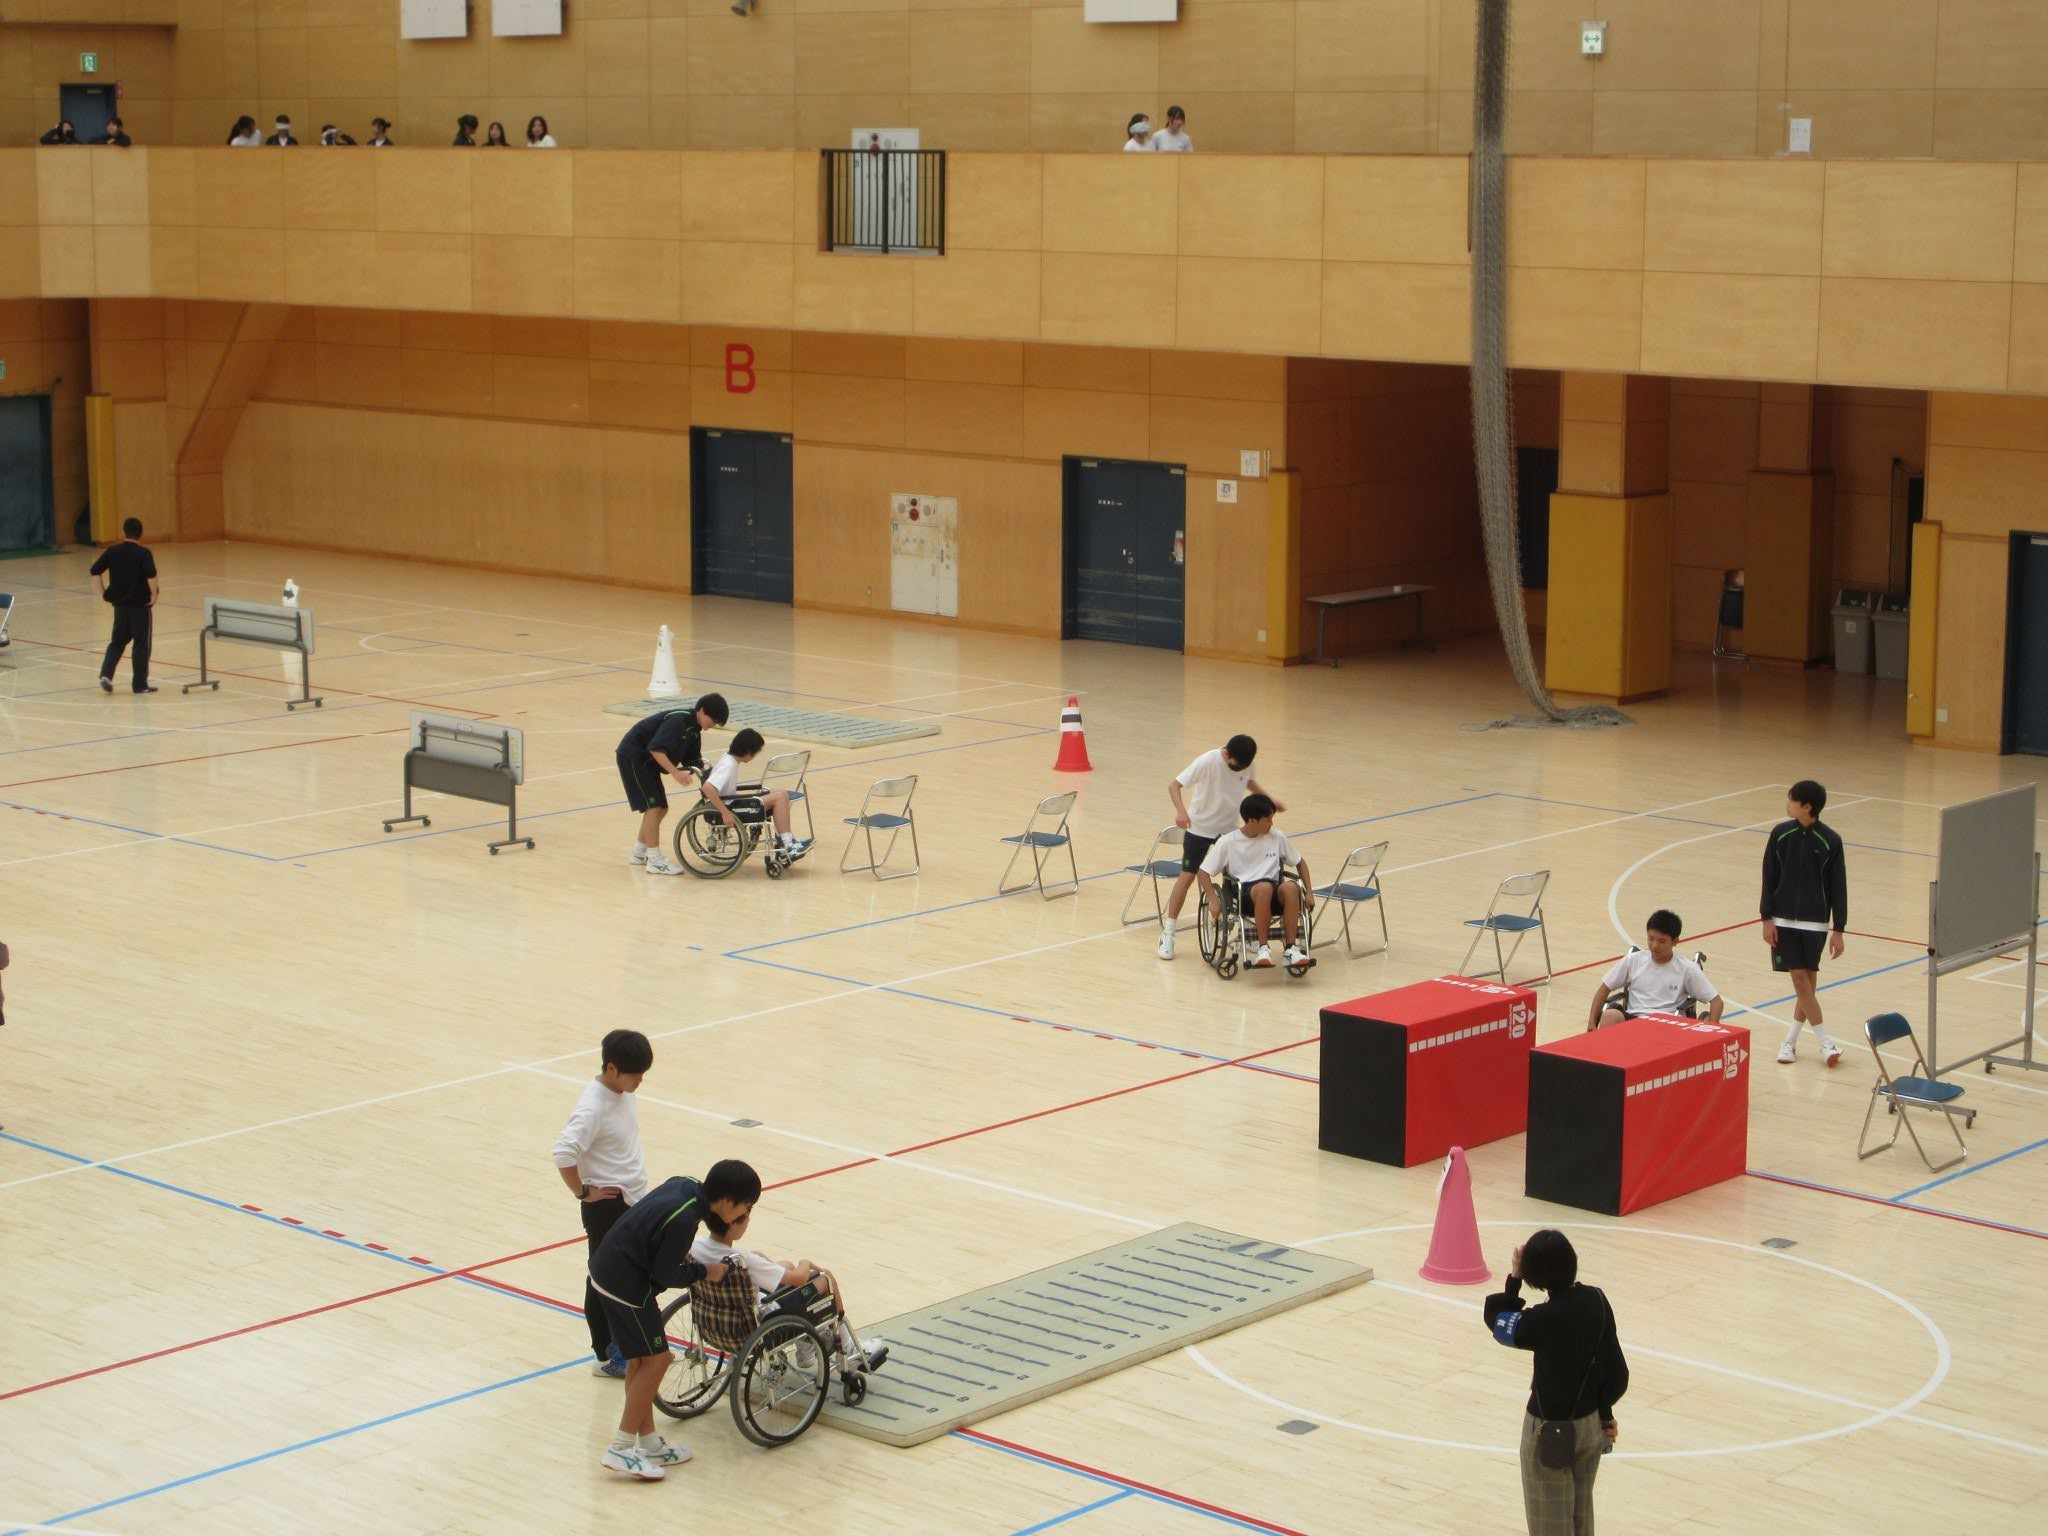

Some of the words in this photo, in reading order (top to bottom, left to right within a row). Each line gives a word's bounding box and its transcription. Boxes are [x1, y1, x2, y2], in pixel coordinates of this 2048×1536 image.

[726, 343, 756, 394] B
[1512, 1000, 1526, 1039] 120
[1727, 1040, 1739, 1079] 120
